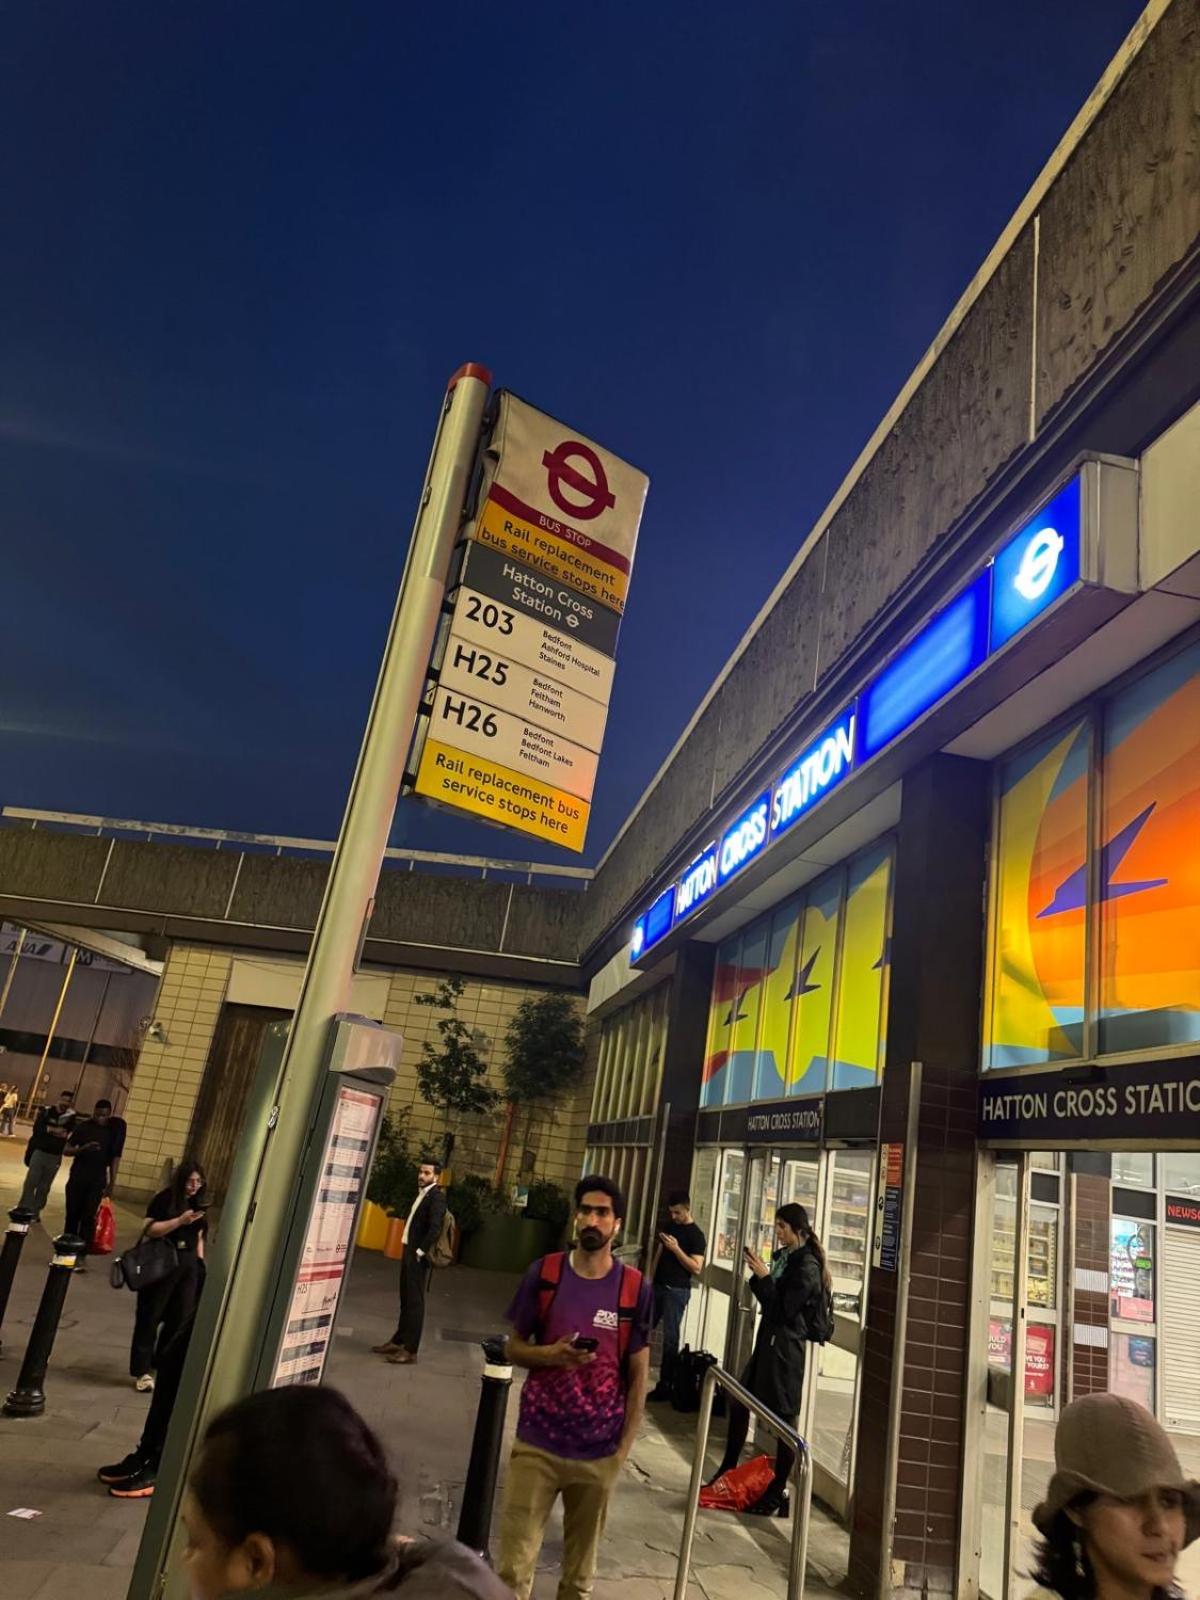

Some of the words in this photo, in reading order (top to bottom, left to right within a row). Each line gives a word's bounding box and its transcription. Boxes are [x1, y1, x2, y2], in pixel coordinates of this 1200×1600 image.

[539, 516, 561, 534] BUS
[564, 529, 592, 549] STOP
[481, 527, 507, 550] bus
[511, 541, 559, 575] service
[562, 563, 598, 595] stops
[601, 584, 625, 610] here
[503, 520, 530, 542] Rail
[534, 537, 616, 586] replacement
[502, 563, 553, 598] Hatton
[557, 590, 594, 620] Cross
[511, 587, 562, 621] Station
[465, 597, 515, 636] 203
[542, 630, 572, 650] Bedfont
[453, 645, 509, 686] H25
[539, 652, 566, 671] Staines
[541, 642, 570, 662] Ashford
[571, 654, 600, 677] Hospital
[530, 689, 561, 708] Feltham
[532, 678, 563, 698] Bedfont
[442, 696, 498, 738] H26
[528, 699, 566, 722] Hanworth
[521, 739, 552, 758] Bedfont
[553, 749, 573, 767] Lakes
[523, 728, 554, 747] Bedfont
[519, 750, 550, 768] Feltham
[435, 753, 464, 775] Rail
[468, 765, 555, 809] replacement
[558, 799, 580, 820] bus
[720, 804, 767, 876] CROSS
[771, 715, 856, 830] STATION
[442, 776, 495, 806] service
[498, 794, 537, 821] stops
[540, 812, 568, 834] here
[748, 1114, 770, 1131] HATTON
[771, 1112, 791, 1130] CROSS
[792, 1110, 819, 1129] STATION
[982, 1093, 1047, 1121] HATTON
[1053, 1086, 1118, 1118] CROSS
